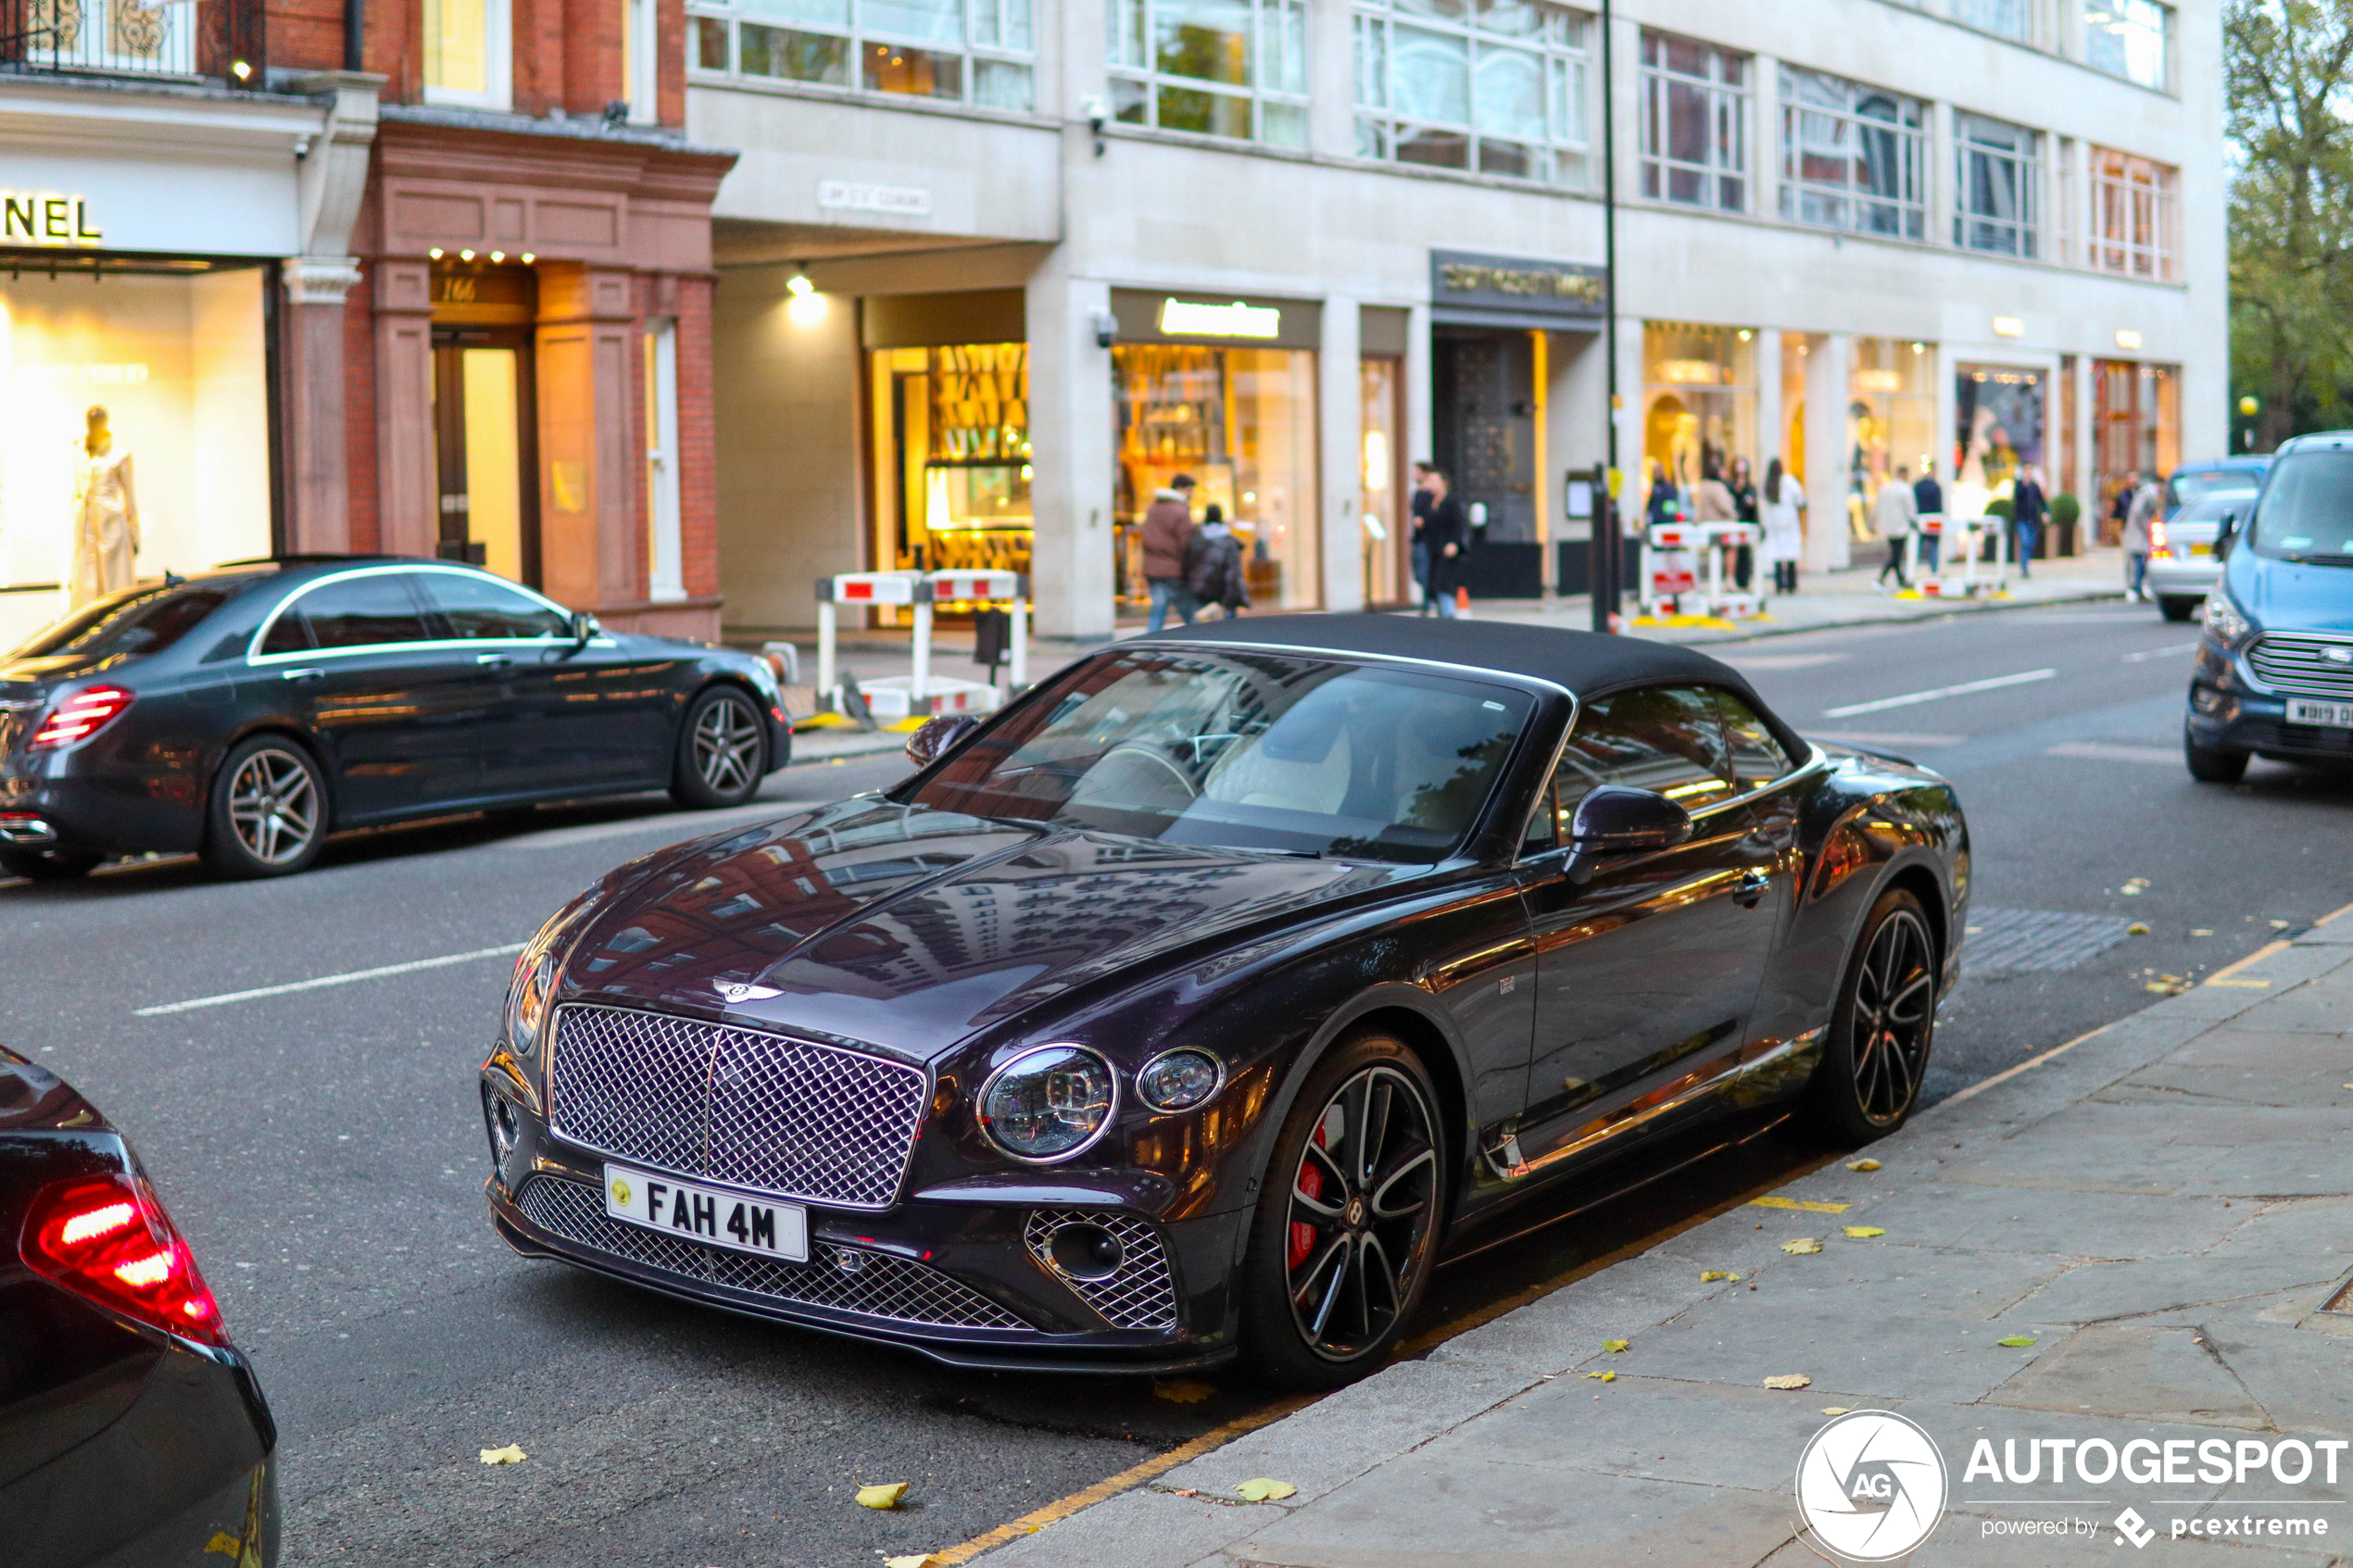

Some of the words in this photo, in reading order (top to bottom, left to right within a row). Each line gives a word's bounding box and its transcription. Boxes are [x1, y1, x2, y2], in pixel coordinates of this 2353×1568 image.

[5, 196, 103, 238] NEL
[648, 1182, 717, 1237] FAH
[727, 1201, 775, 1249] 4M
